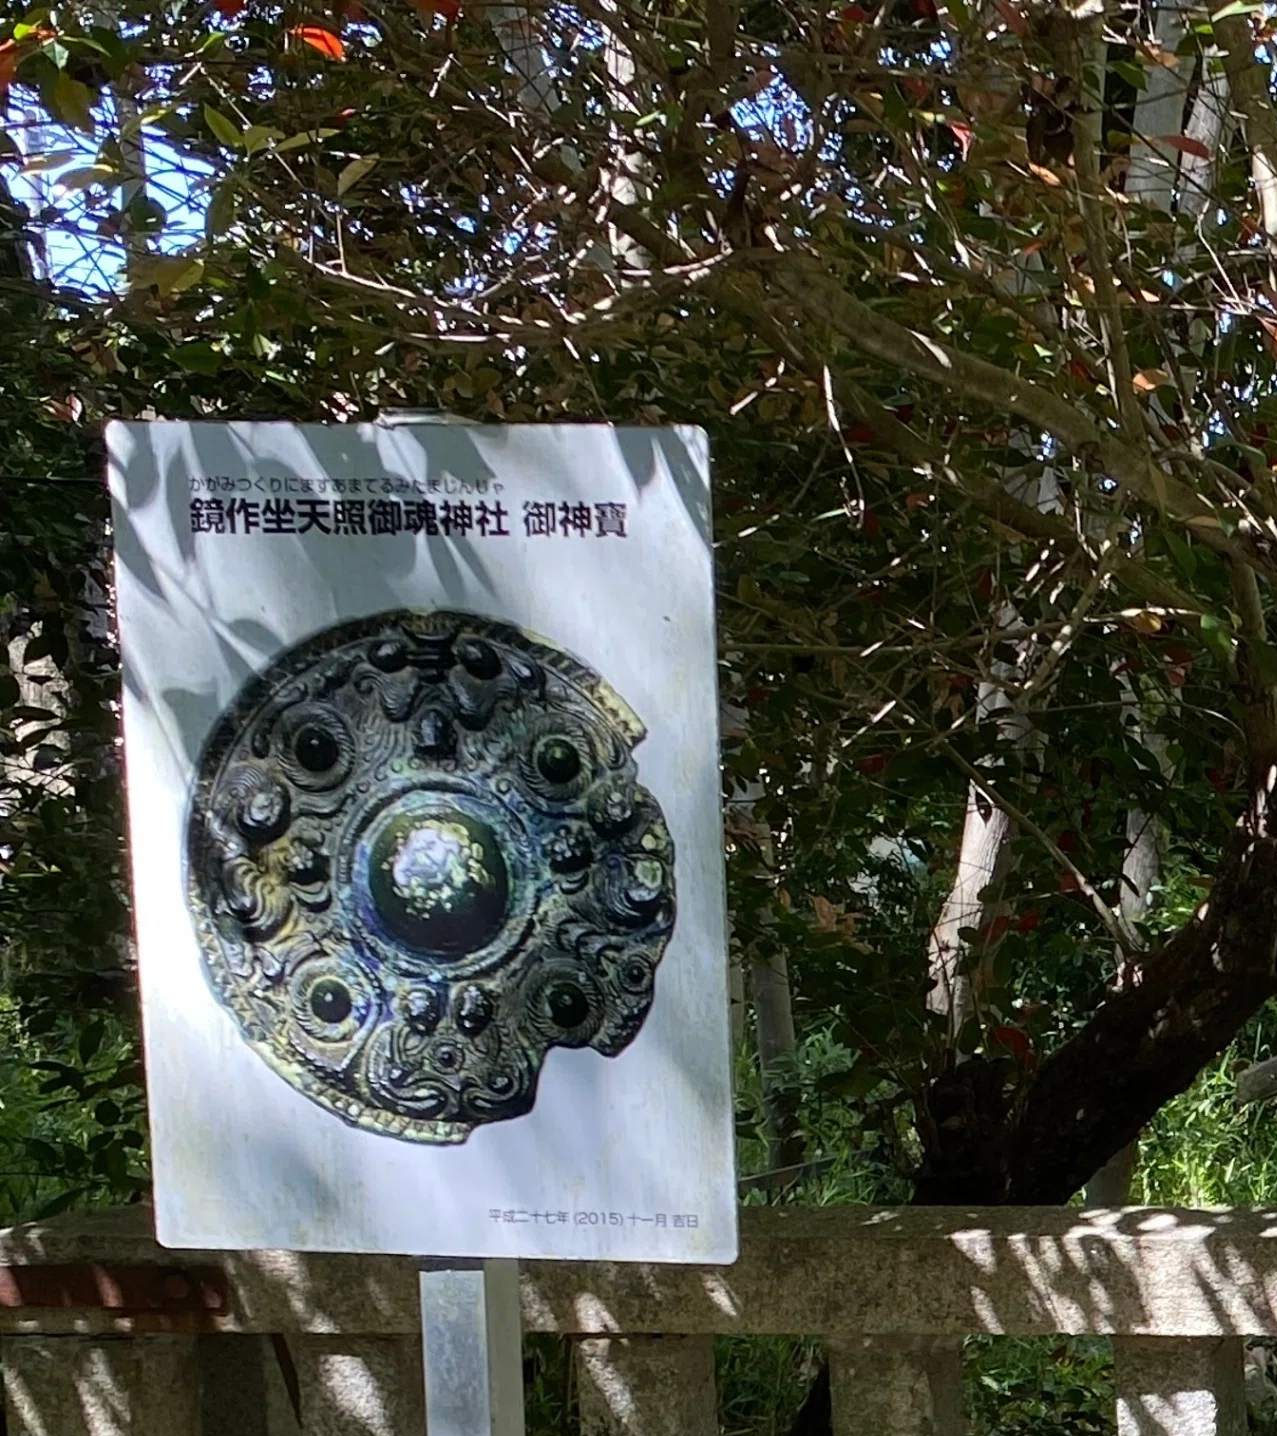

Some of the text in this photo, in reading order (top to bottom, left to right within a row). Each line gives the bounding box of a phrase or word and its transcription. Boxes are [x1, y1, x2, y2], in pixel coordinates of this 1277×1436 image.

[190, 498, 509, 537] 鏡作坐天照御魂神社
[488, 1208, 569, 1225] 平成二十七年
[573, 1211, 624, 1227] (2015)
[627, 1212, 668, 1228] 十一月
